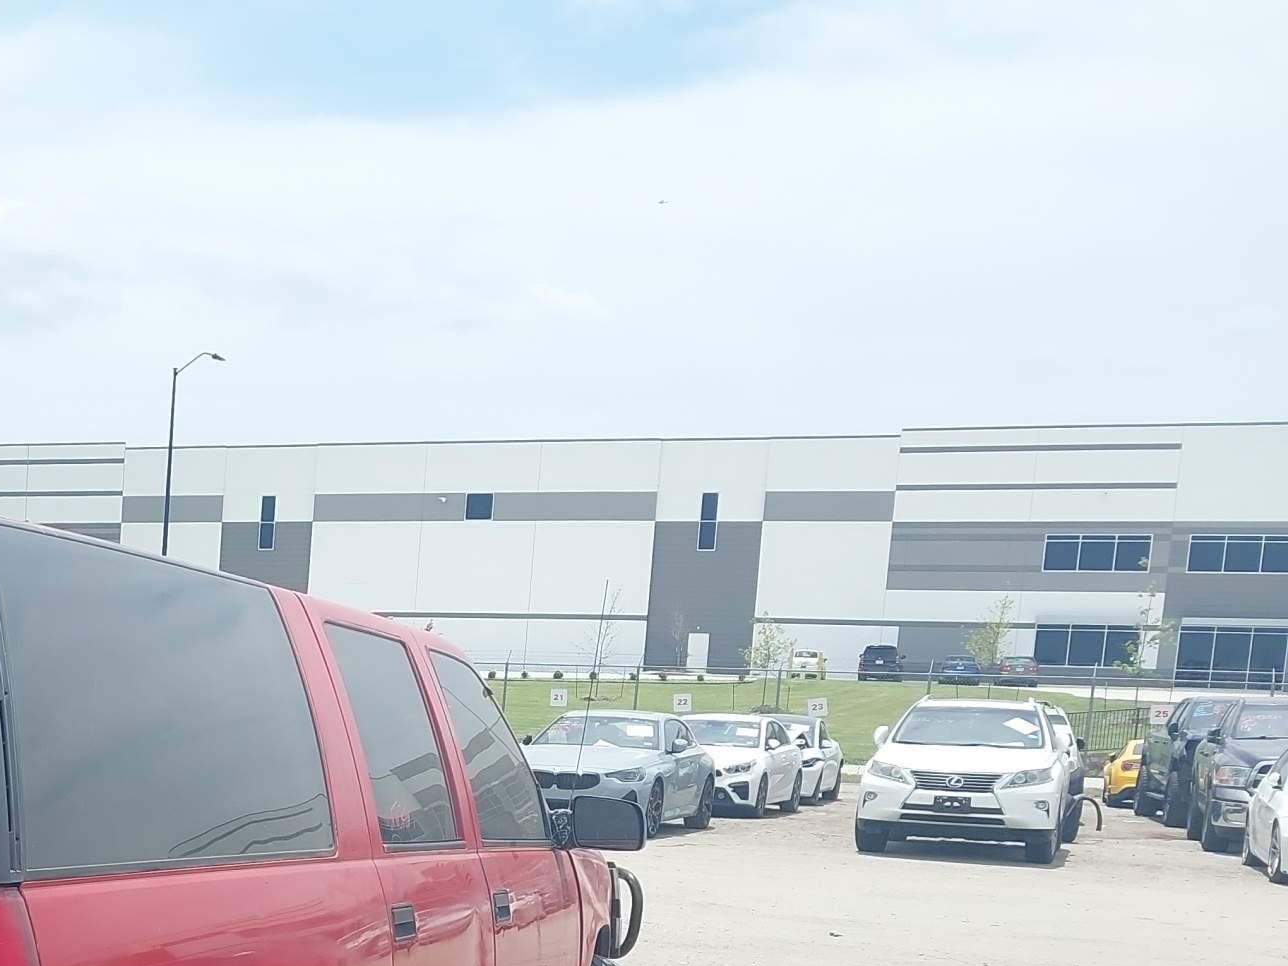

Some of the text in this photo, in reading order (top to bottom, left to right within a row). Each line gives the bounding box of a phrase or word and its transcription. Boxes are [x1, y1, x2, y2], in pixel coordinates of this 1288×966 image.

[677, 698, 689, 706] 22
[811, 703, 824, 711] 23
[1154, 710, 1169, 718] 25
